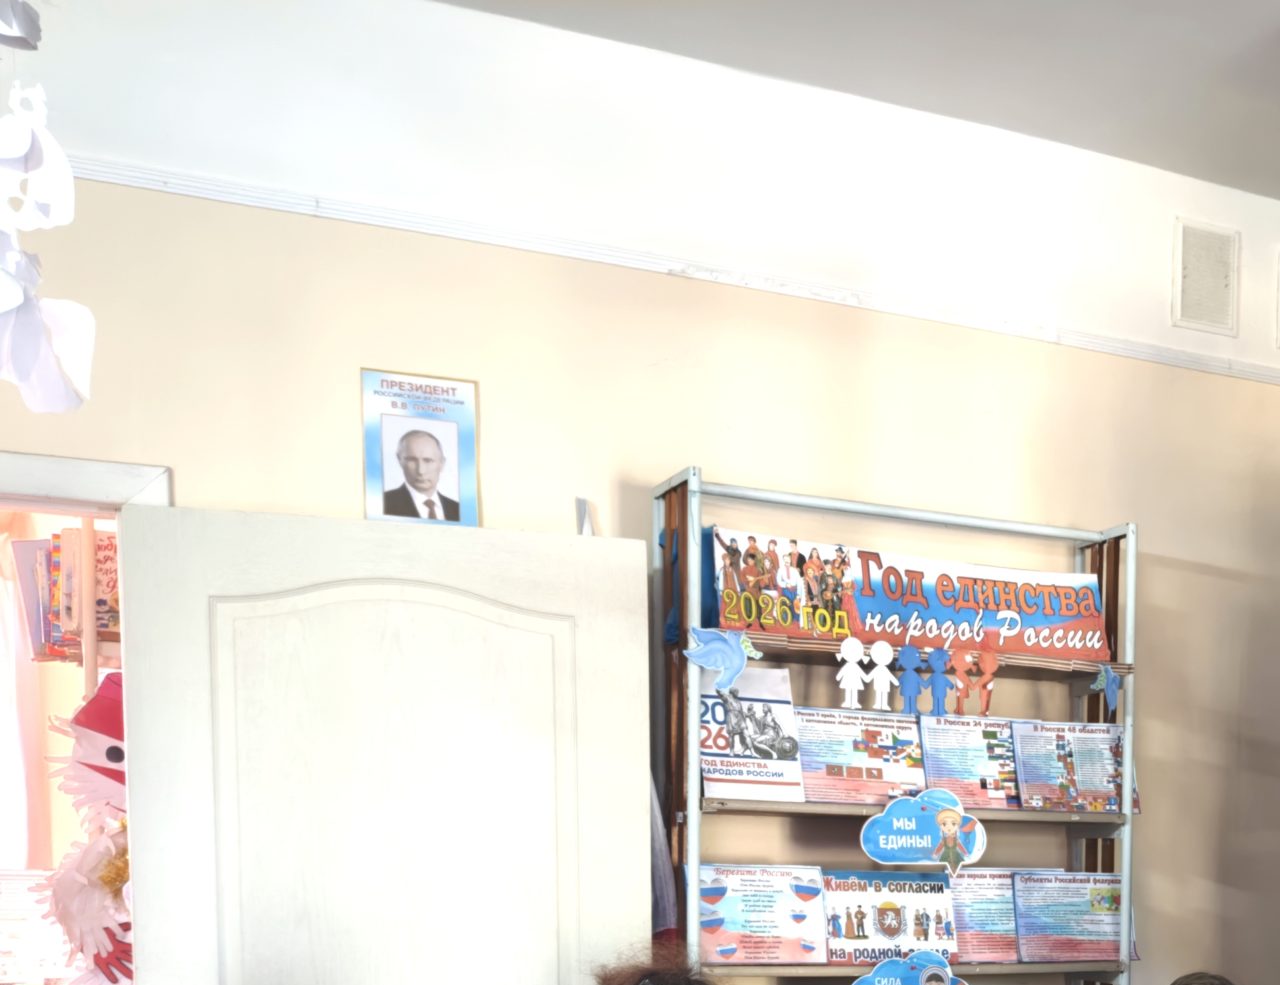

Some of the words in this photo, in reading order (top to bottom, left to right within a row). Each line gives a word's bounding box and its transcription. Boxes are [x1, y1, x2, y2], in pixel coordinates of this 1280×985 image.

[380, 379, 457, 396] ПРЕЗИДЕНТ
[412, 403, 446, 414] ПУТИН
[857, 550, 929, 609] Год
[935, 573, 1099, 618] единства
[723, 588, 793, 628] 2026
[802, 605, 851, 639] год
[865, 608, 984, 649] народов
[996, 609, 1104, 650] России
[700, 701, 728, 726] 20
[700, 725, 731, 750] 26
[719, 759, 768, 769] ЕДИНСТВА
[746, 770, 784, 778] РОССИИ
[892, 817, 916, 831] МЫ
[879, 834, 932, 849] ЕДИНЫ!
[713, 867, 757, 879] Берегите
[823, 876, 868, 892] Живём
[874, 882, 882, 893] в
[888, 881, 944, 894] согласии
[830, 949, 846, 961] на
[854, 944, 902, 964] родной
